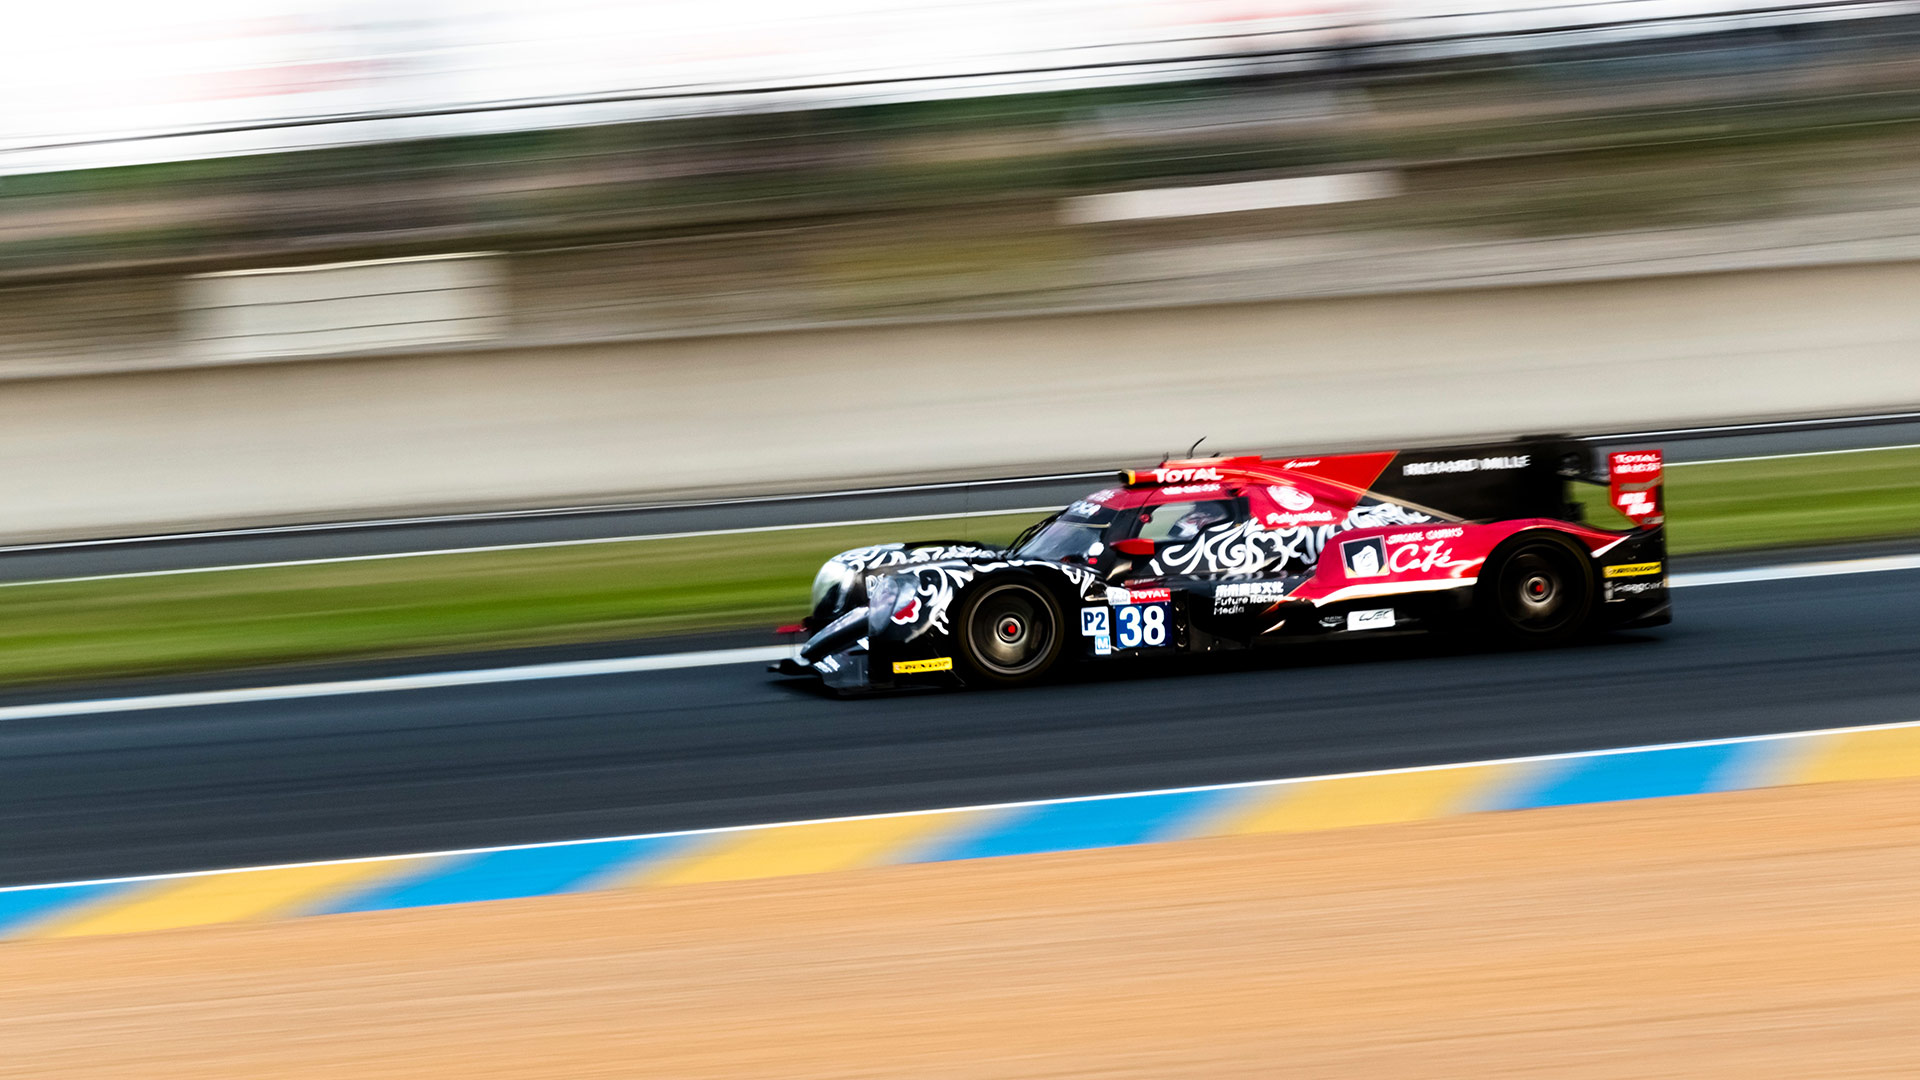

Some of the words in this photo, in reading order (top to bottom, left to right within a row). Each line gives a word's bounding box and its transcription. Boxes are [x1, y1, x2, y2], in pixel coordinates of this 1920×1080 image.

[1403, 459, 1479, 476] RICHARD
[1480, 455, 1531, 471] MILLE
[1613, 453, 1661, 464] TOTAL
[1152, 467, 1224, 484] TOTAL
[1131, 589, 1169, 600] TOTAL
[1214, 596, 1249, 606] Future
[1213, 604, 1245, 616] Media
[1083, 611, 1107, 631] P2
[1119, 605, 1166, 647] 38
